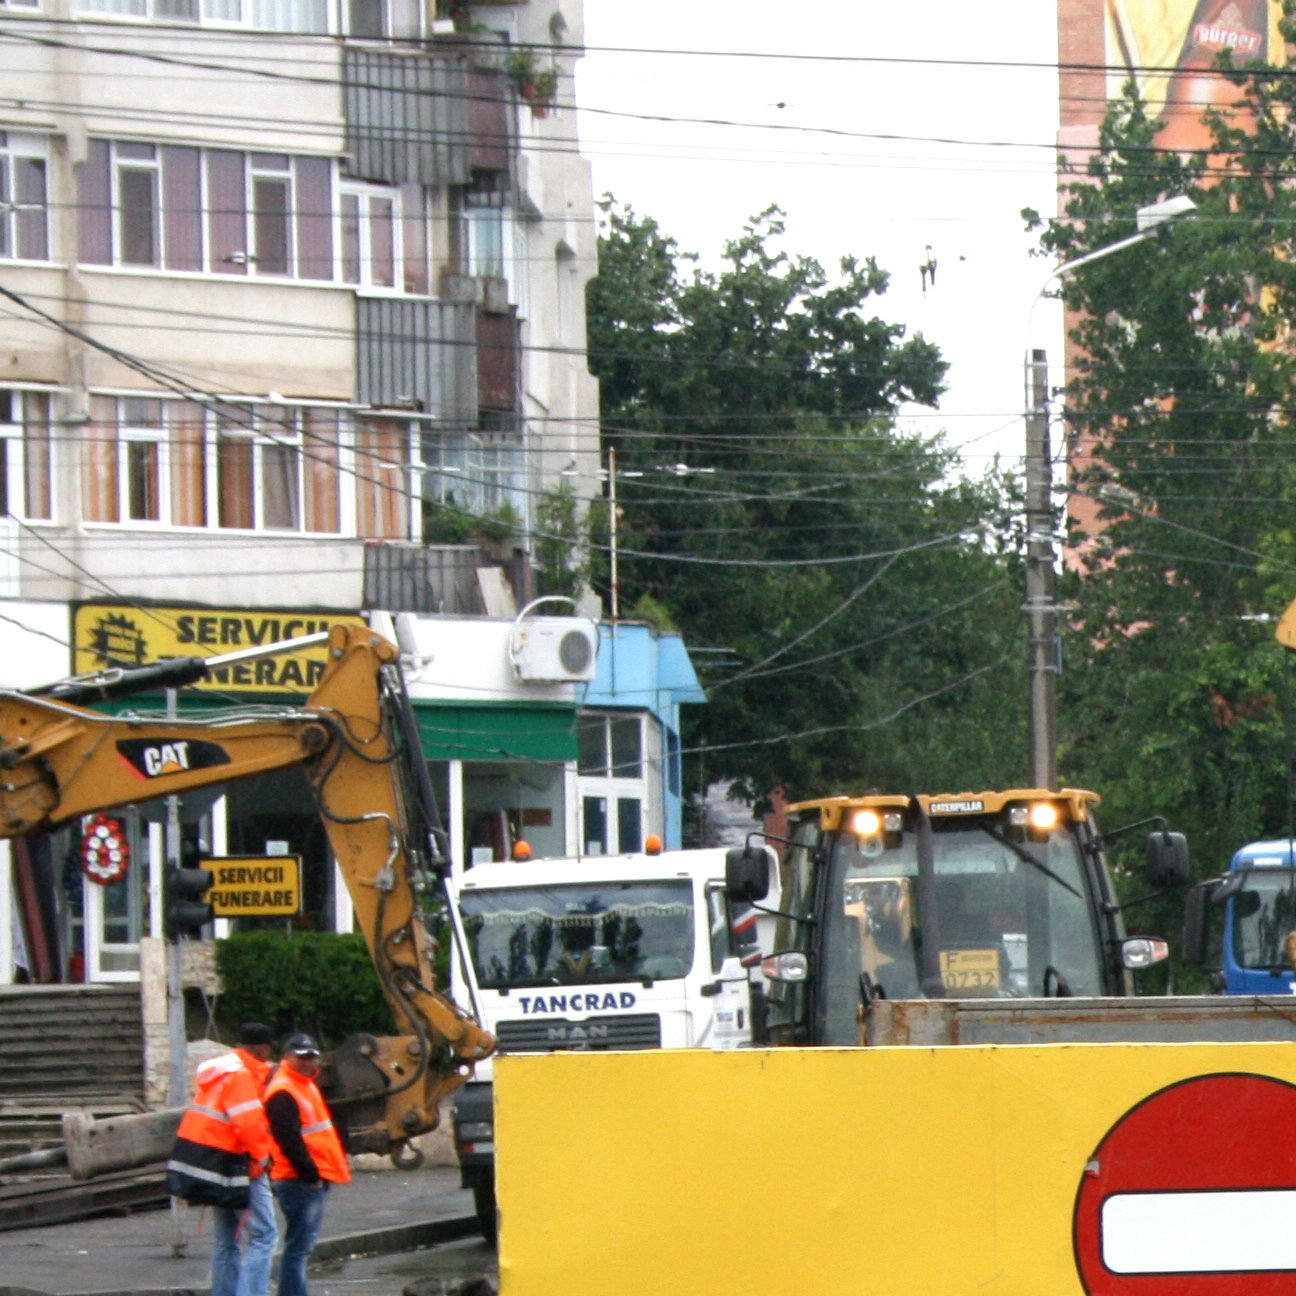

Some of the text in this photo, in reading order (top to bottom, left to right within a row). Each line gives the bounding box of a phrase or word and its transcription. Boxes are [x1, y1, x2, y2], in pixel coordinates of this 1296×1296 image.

[143, 741, 189, 777] CAT
[218, 866, 284, 884] SERVICII
[210, 890, 293, 907] FUNERARE
[519, 991, 637, 1014] TANCRAD
[547, 1026, 608, 1040] MAN
